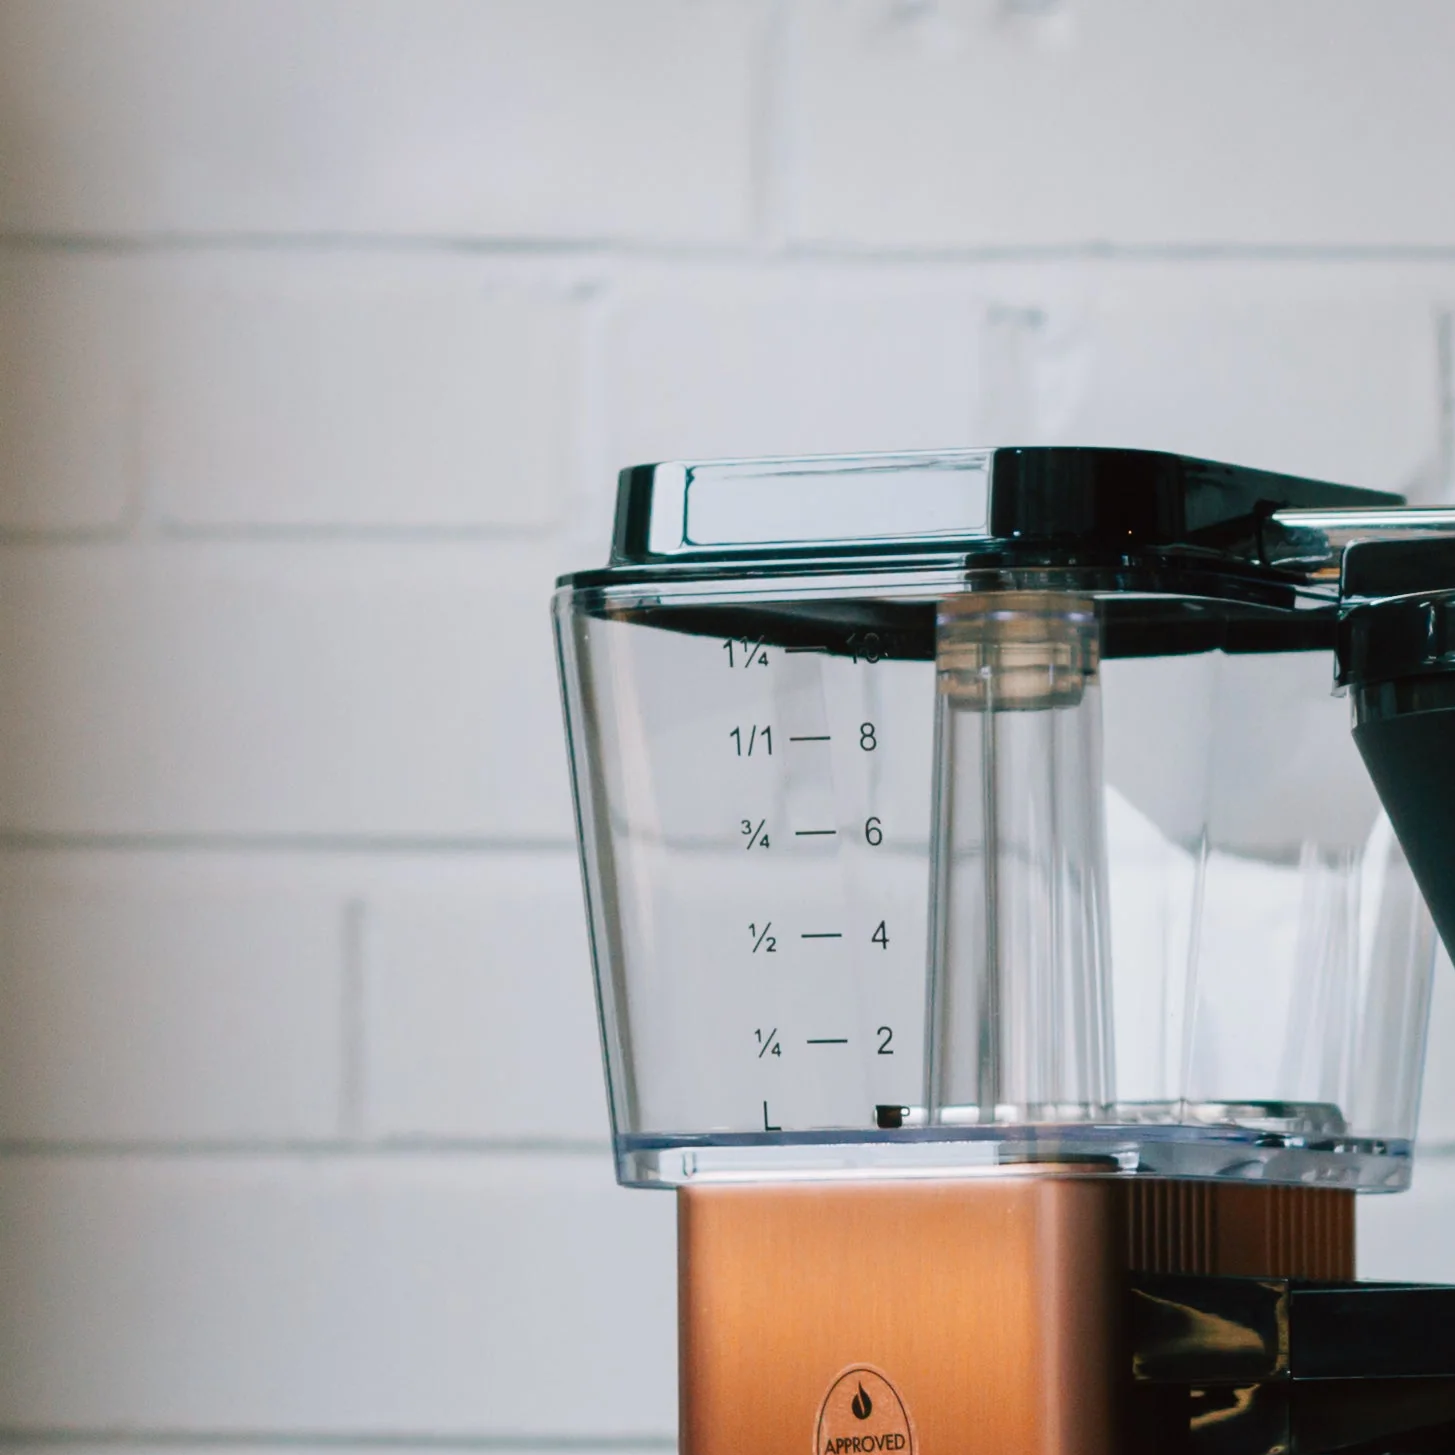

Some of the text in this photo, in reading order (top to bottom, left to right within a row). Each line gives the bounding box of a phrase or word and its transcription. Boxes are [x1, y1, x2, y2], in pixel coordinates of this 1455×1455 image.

[730, 722, 877, 756] 1/1 8
[865, 816, 883, 846] 6
[871, 920, 890, 950] 4
[877, 1026, 894, 1055] 2
[763, 1100, 782, 1131] L
[825, 1433, 905, 1455] APPROVED
